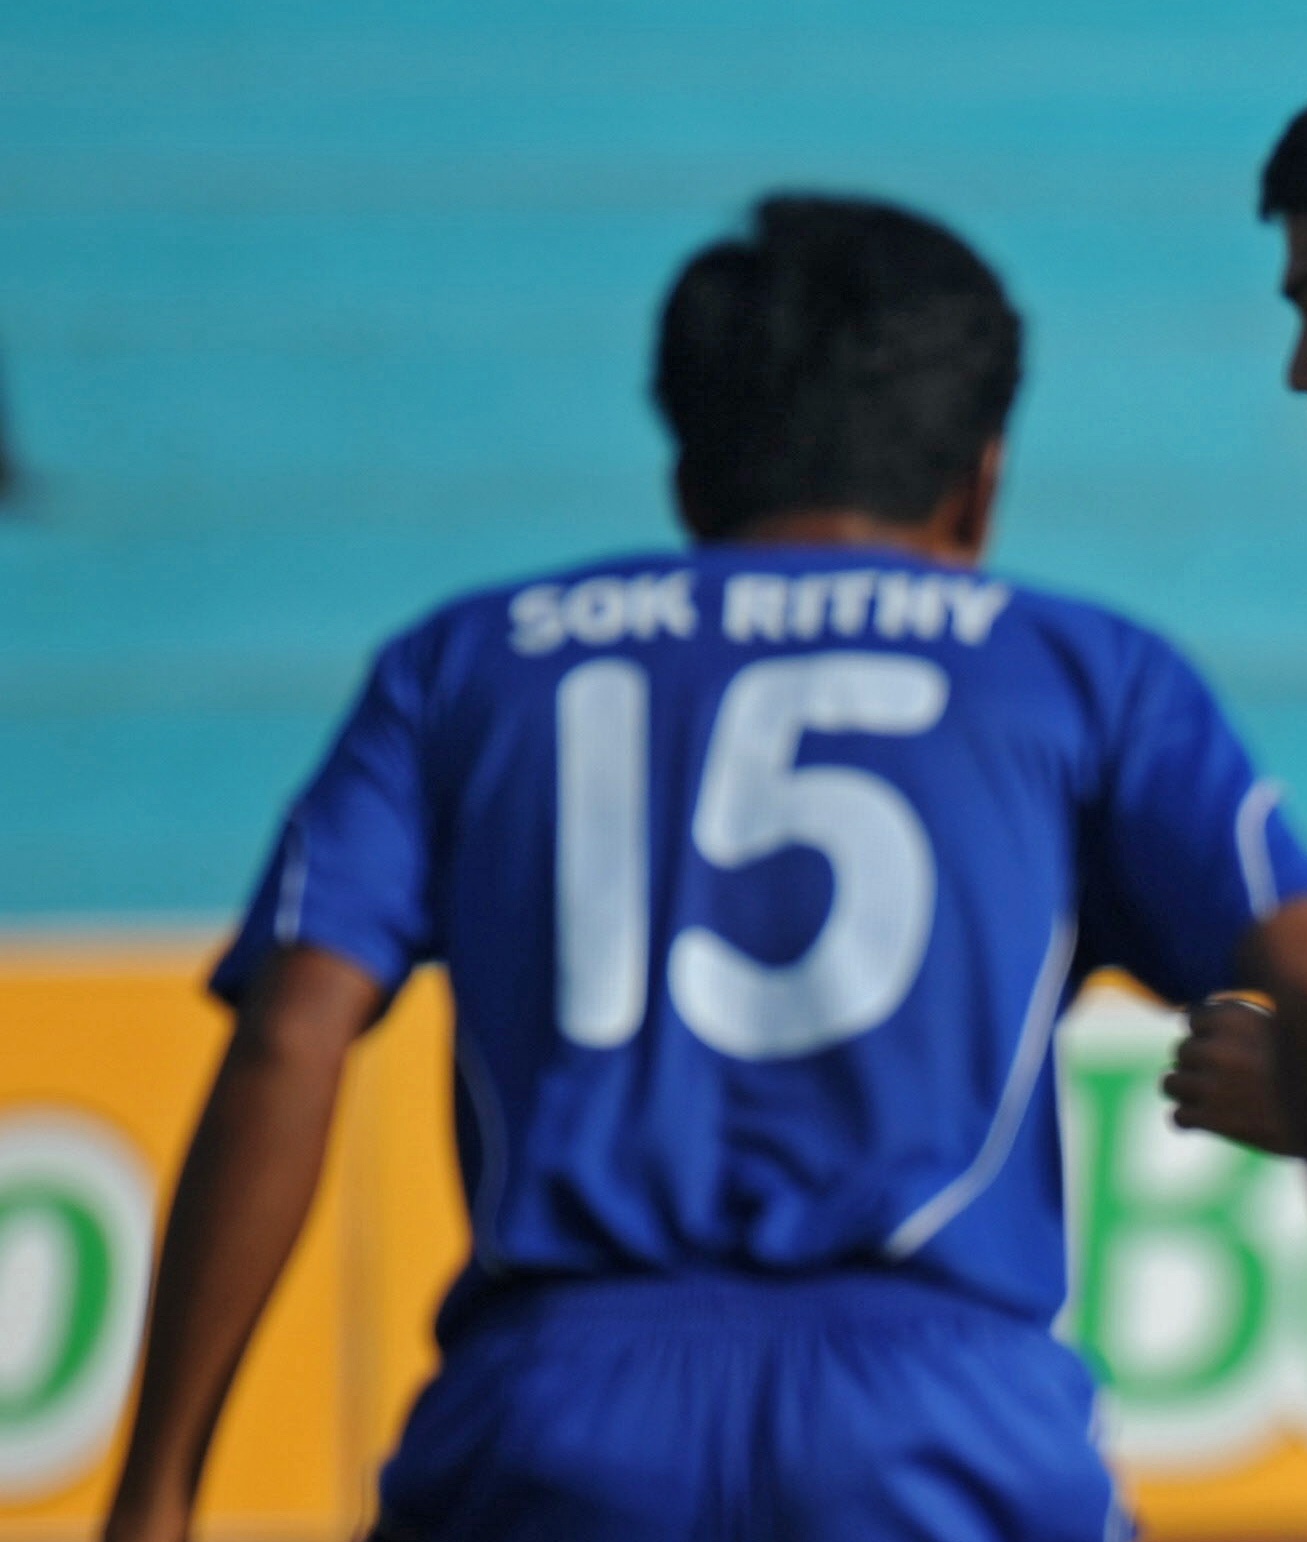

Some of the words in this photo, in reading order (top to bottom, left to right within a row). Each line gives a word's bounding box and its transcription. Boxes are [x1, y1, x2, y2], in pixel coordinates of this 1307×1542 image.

[508, 568, 698, 657] SOK
[722, 568, 1009, 648] RITHY
[555, 650, 951, 1063] 15
